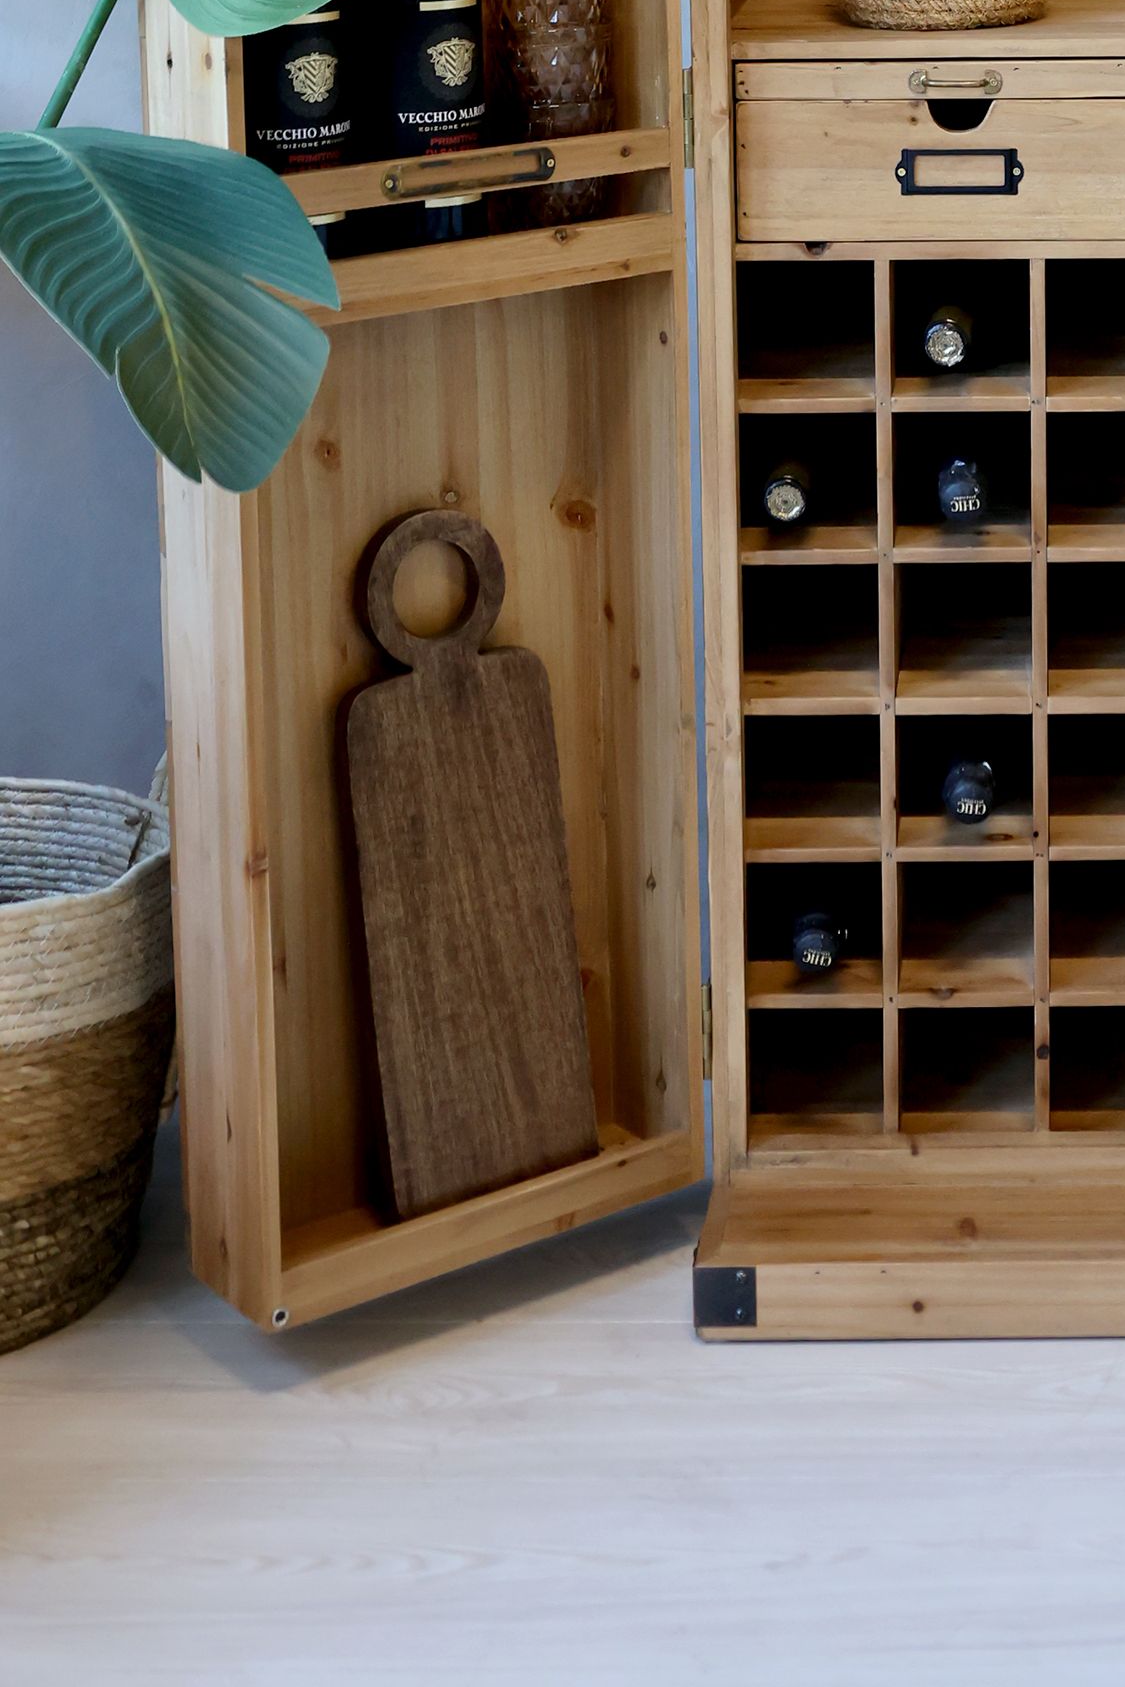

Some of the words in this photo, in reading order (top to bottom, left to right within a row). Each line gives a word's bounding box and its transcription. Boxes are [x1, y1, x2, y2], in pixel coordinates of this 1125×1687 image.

[397, 110, 457, 124] VECCHIO
[256, 127, 317, 141] VECCHIO
[418, 123, 459, 132] EDIZIONE
[950, 498, 981, 513] CHIC
[956, 800, 987, 816] CHIC
[802, 950, 832, 969] CHIC
